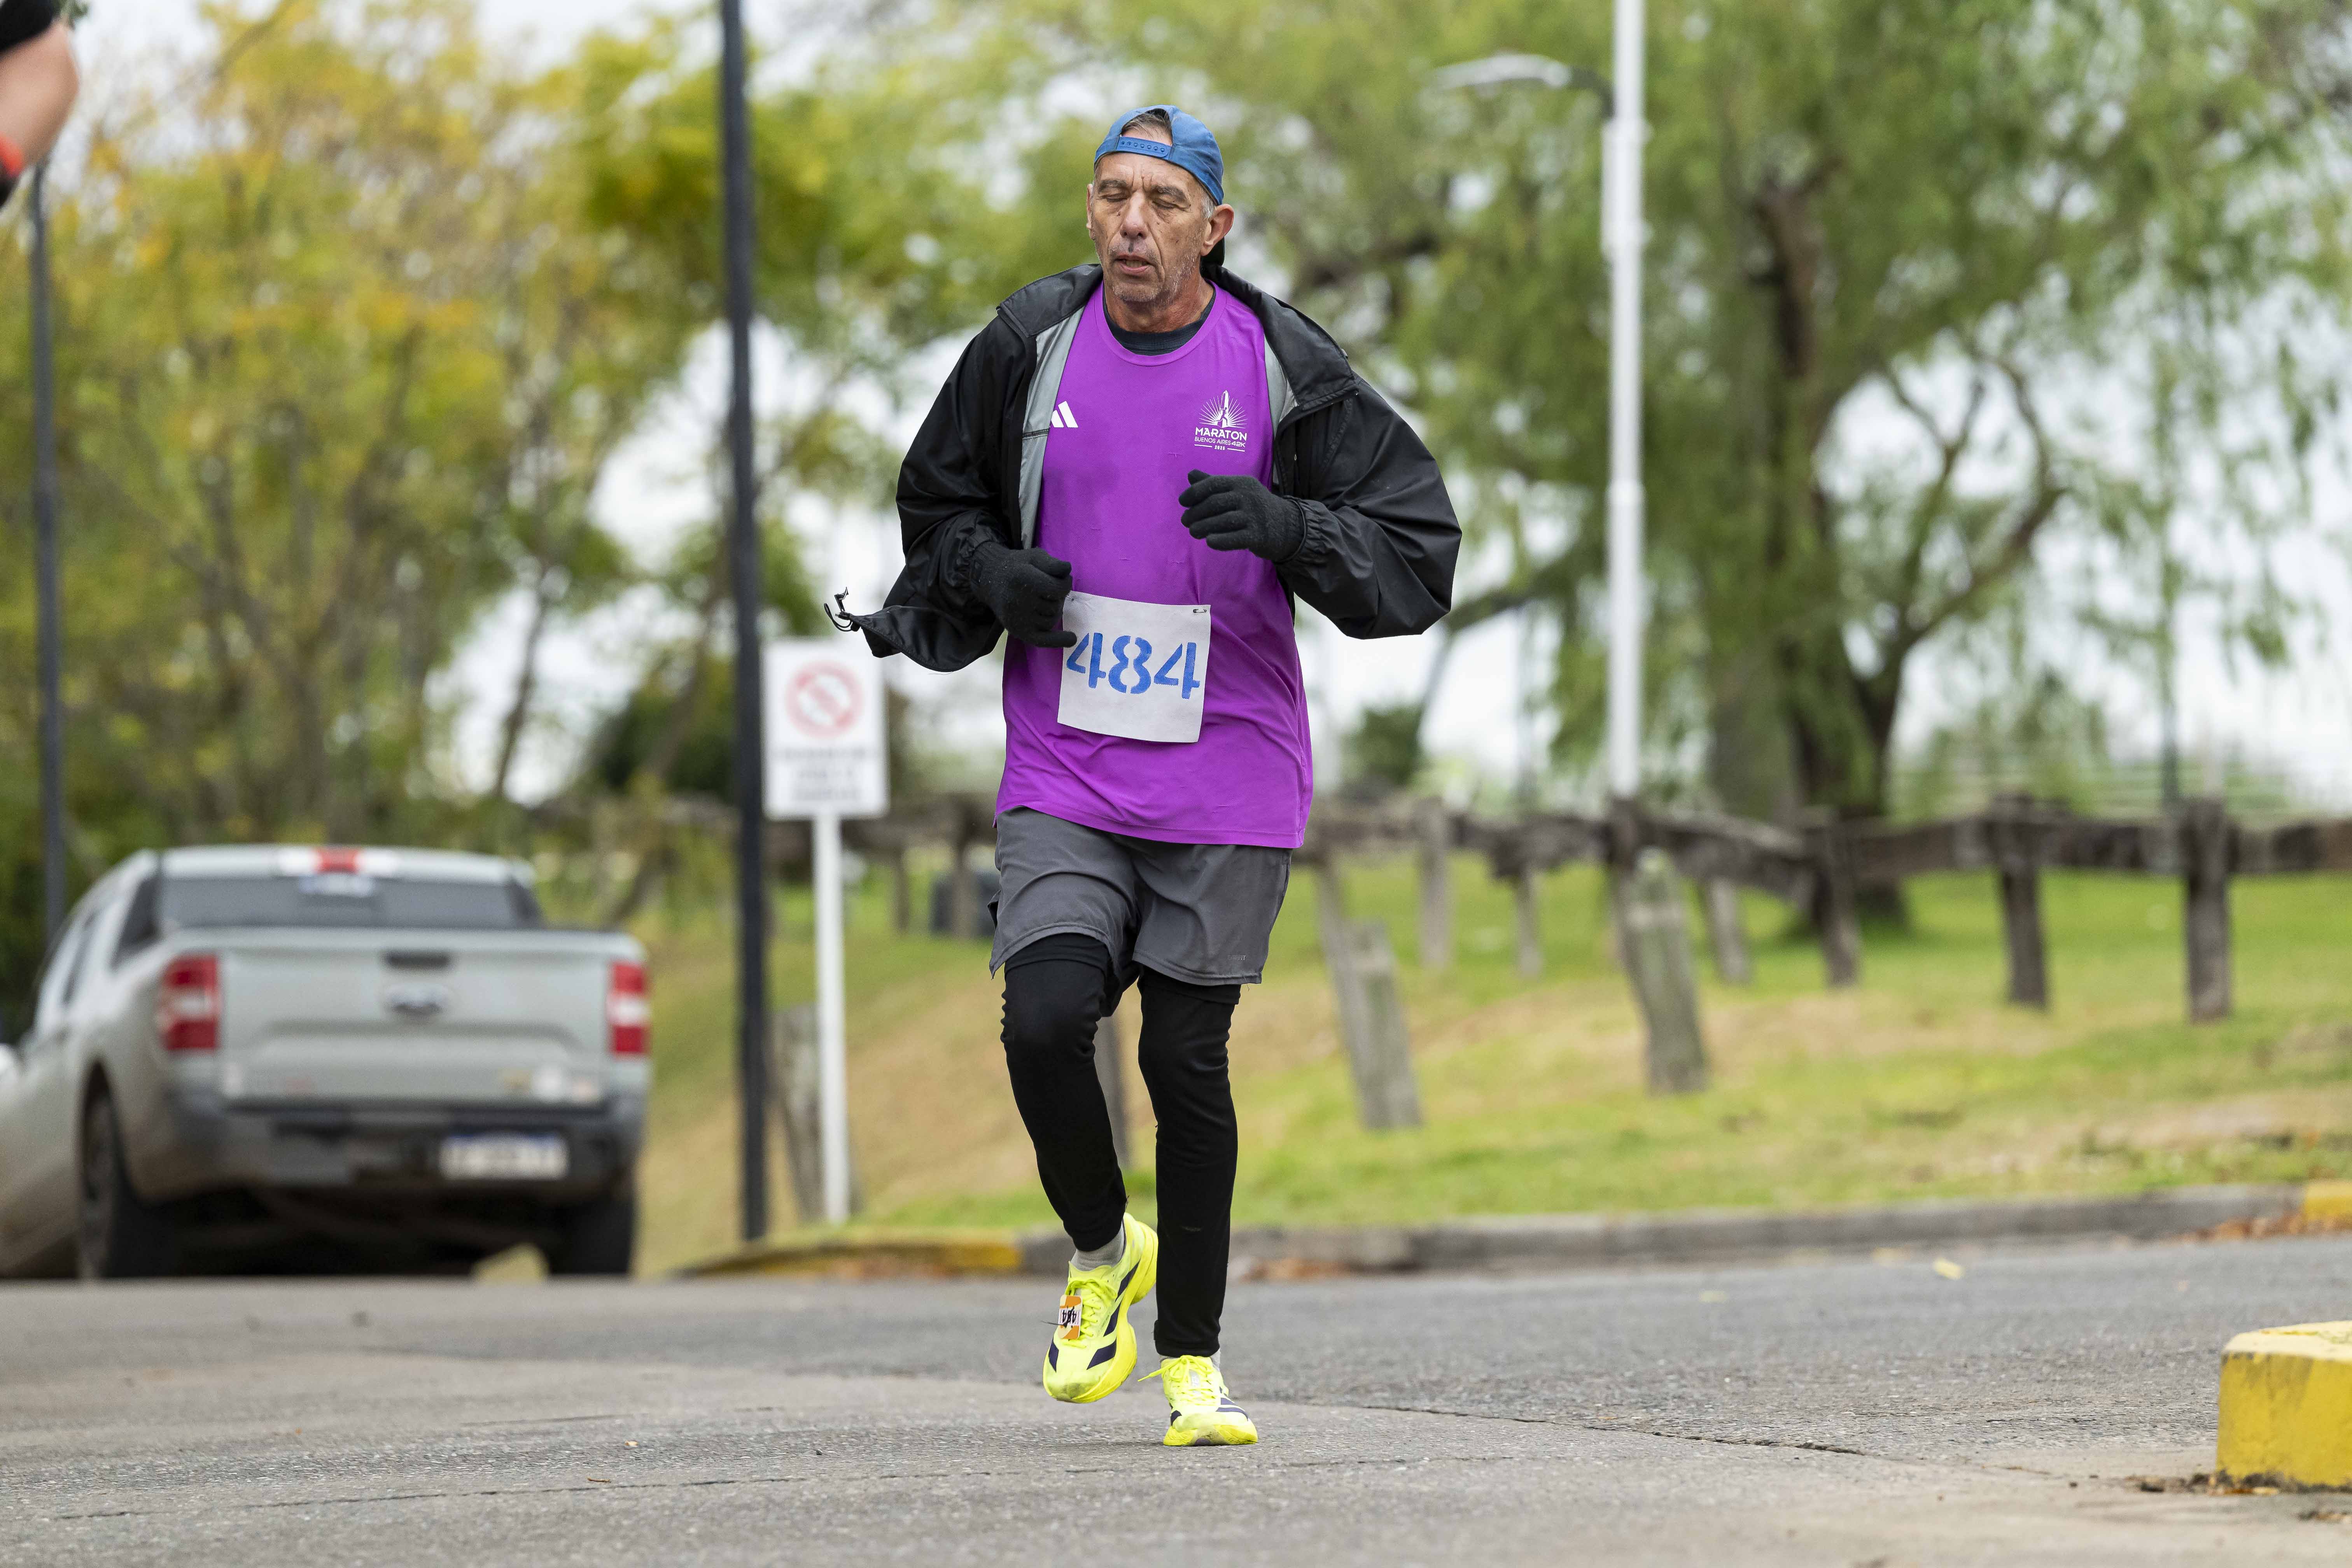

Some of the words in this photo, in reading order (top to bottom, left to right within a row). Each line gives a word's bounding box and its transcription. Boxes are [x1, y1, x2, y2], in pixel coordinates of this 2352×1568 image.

[1195, 427, 1247, 441] MARATON
[1066, 632, 1200, 700] 484
[1062, 1309, 1077, 1323] 484
